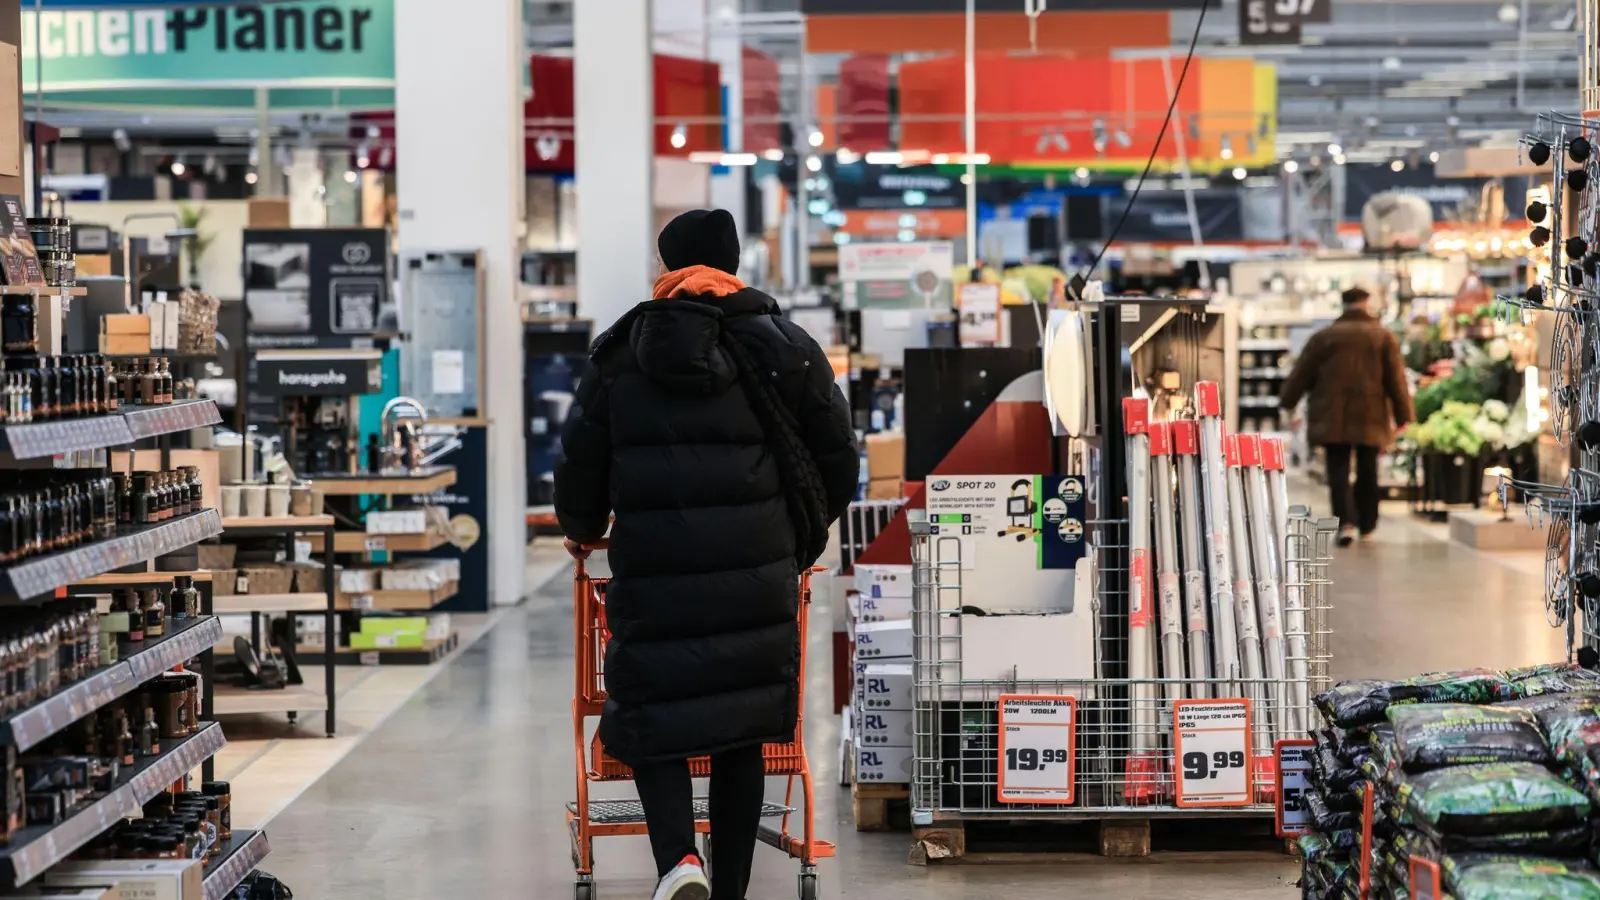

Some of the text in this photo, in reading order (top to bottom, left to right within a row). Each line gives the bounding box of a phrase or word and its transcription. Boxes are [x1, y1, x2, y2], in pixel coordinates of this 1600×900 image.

[278, 370, 347, 387] hansgrohe
[956, 481, 981, 490] SPOT
[984, 481, 996, 490] 20
[863, 600, 878, 610] RL
[857, 633, 873, 645] RL
[868, 678, 890, 694] RL
[1004, 699, 1051, 707] Arbeitsleuchte
[1179, 705, 1246, 713] LED-Feuchtraumleuchte
[865, 714, 888, 730] RL
[860, 751, 883, 767] RL
[1005, 748, 1068, 771] 19,99
[1183, 751, 1244, 780] 9,99
